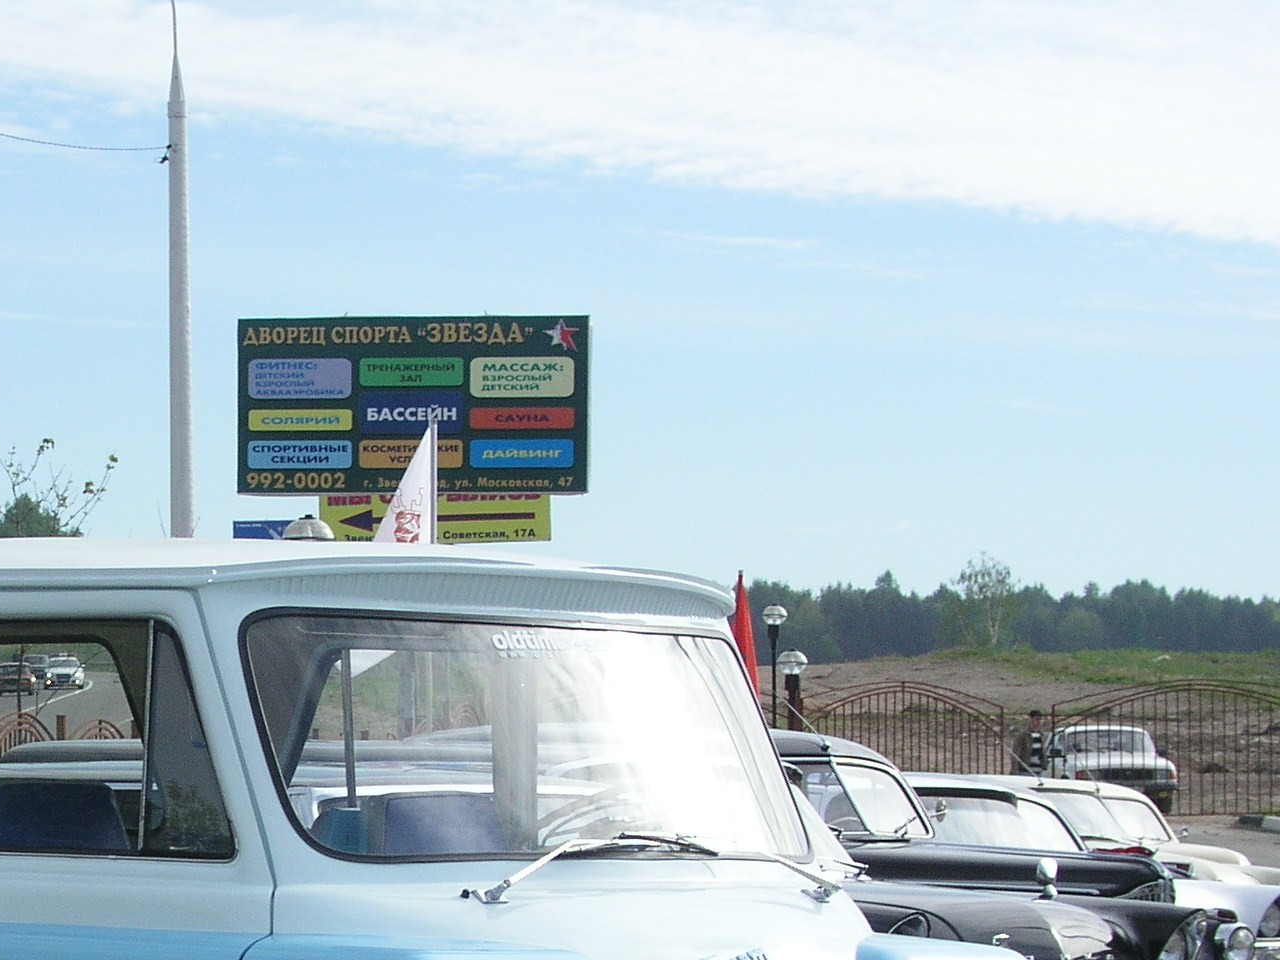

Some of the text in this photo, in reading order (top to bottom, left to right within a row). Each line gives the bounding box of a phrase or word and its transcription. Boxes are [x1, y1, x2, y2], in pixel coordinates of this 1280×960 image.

[243, 327, 326, 346] ДВОРЕЦ
[331, 326, 412, 344] СПОРТА
[255, 361, 318, 371] ФИТНЕС:
[366, 362, 455, 372] ТРЕНАЖЕРНЫЙ
[482, 363, 564, 372] МАССАЖ:
[399, 374, 422, 383] ЗАЛ
[482, 373, 553, 382] ВЗРОСЛЫЙ
[481, 383, 540, 392] ДЕТСКИЙ
[366, 404, 457, 422] БАССЕЙН
[261, 414, 341, 426] СОЛЯРИЙ
[494, 414, 550, 423] САУНА
[252, 444, 349, 454] СПОРТИВНЫЕ
[363, 444, 460, 453] КОСМЕТИКИЕ
[482, 447, 562, 460] ДАЙВИНГ
[271, 455, 330, 465] СЕКЦИИ
[246, 472, 346, 489] 992-0002
[454, 479, 472, 490] ул.
[477, 477, 554, 489] Московская,
[557, 477, 574, 488] 47
[443, 528, 537, 541] Советская, 17А
